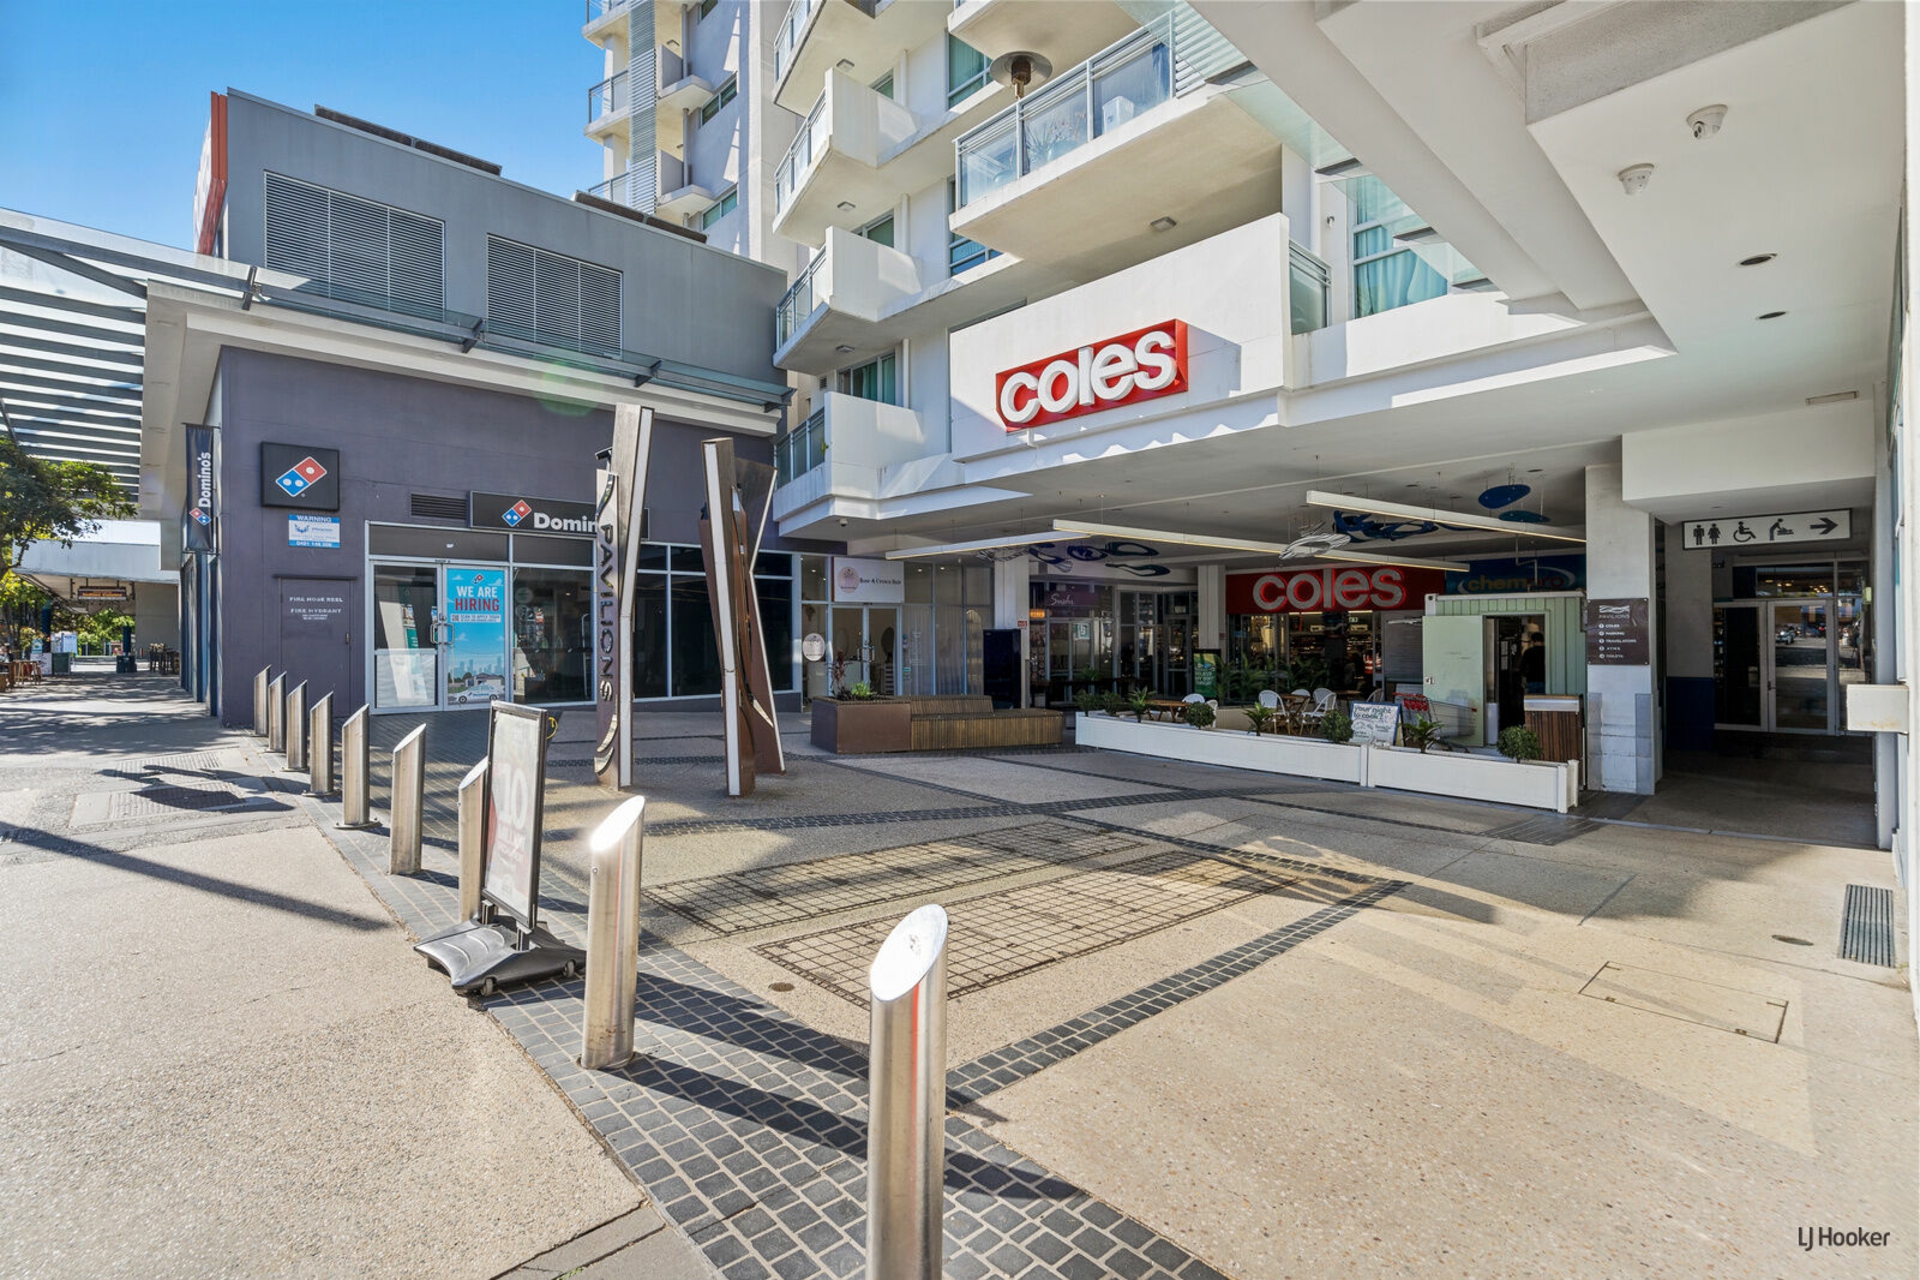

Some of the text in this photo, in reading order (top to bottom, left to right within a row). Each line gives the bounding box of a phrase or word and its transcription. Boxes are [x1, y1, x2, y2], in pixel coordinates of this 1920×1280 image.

[1000, 330, 1178, 423] coles
[197, 452, 211, 508] Domino's
[454, 597, 500, 612] HIRING
[456, 585, 498, 599] WE ARE
[600, 523, 614, 701] PAVILIONS
[1253, 568, 1403, 611] coles
